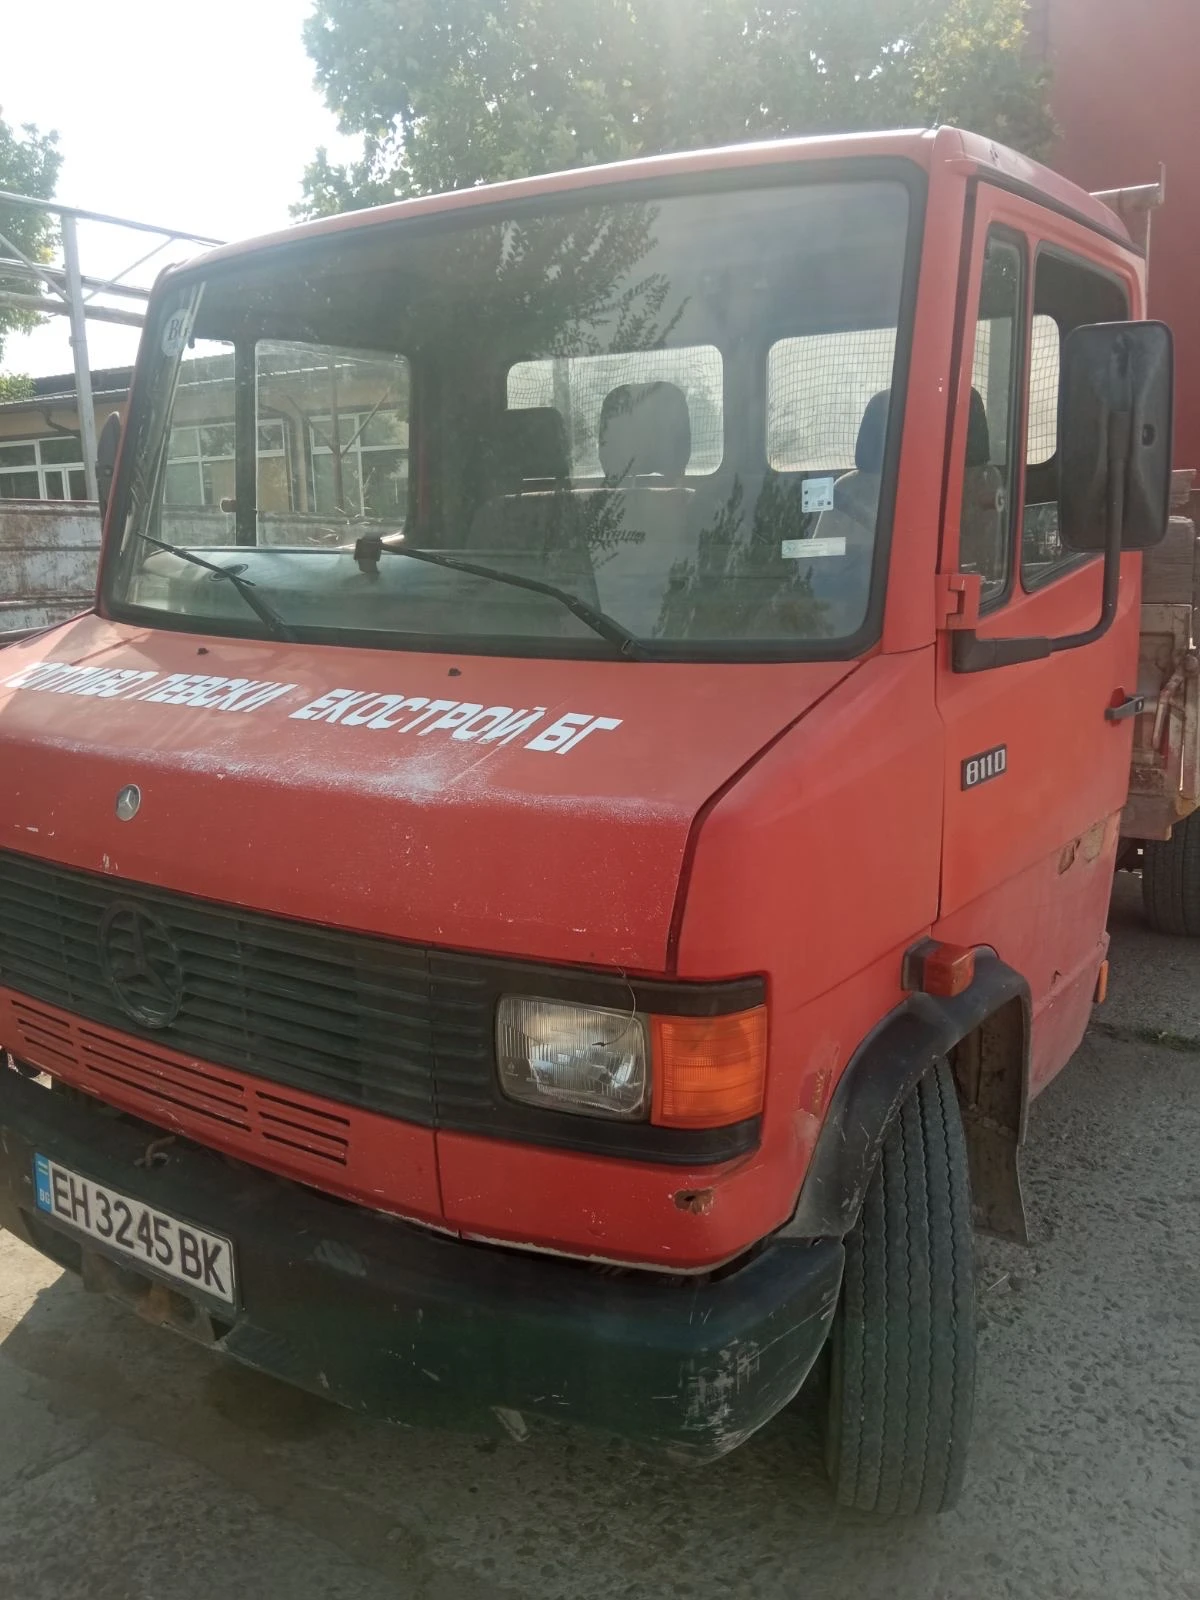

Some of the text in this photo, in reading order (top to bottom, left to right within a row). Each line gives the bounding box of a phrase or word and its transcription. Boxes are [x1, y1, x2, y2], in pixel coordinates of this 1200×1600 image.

[121, 673, 300, 713] ЛЕВСКИ
[288, 688, 548, 747] ЕКОСТРОЙ
[524, 712, 623, 755] БГ
[966, 749, 1006, 785] 8110
[39, 1187, 50, 1205] BG
